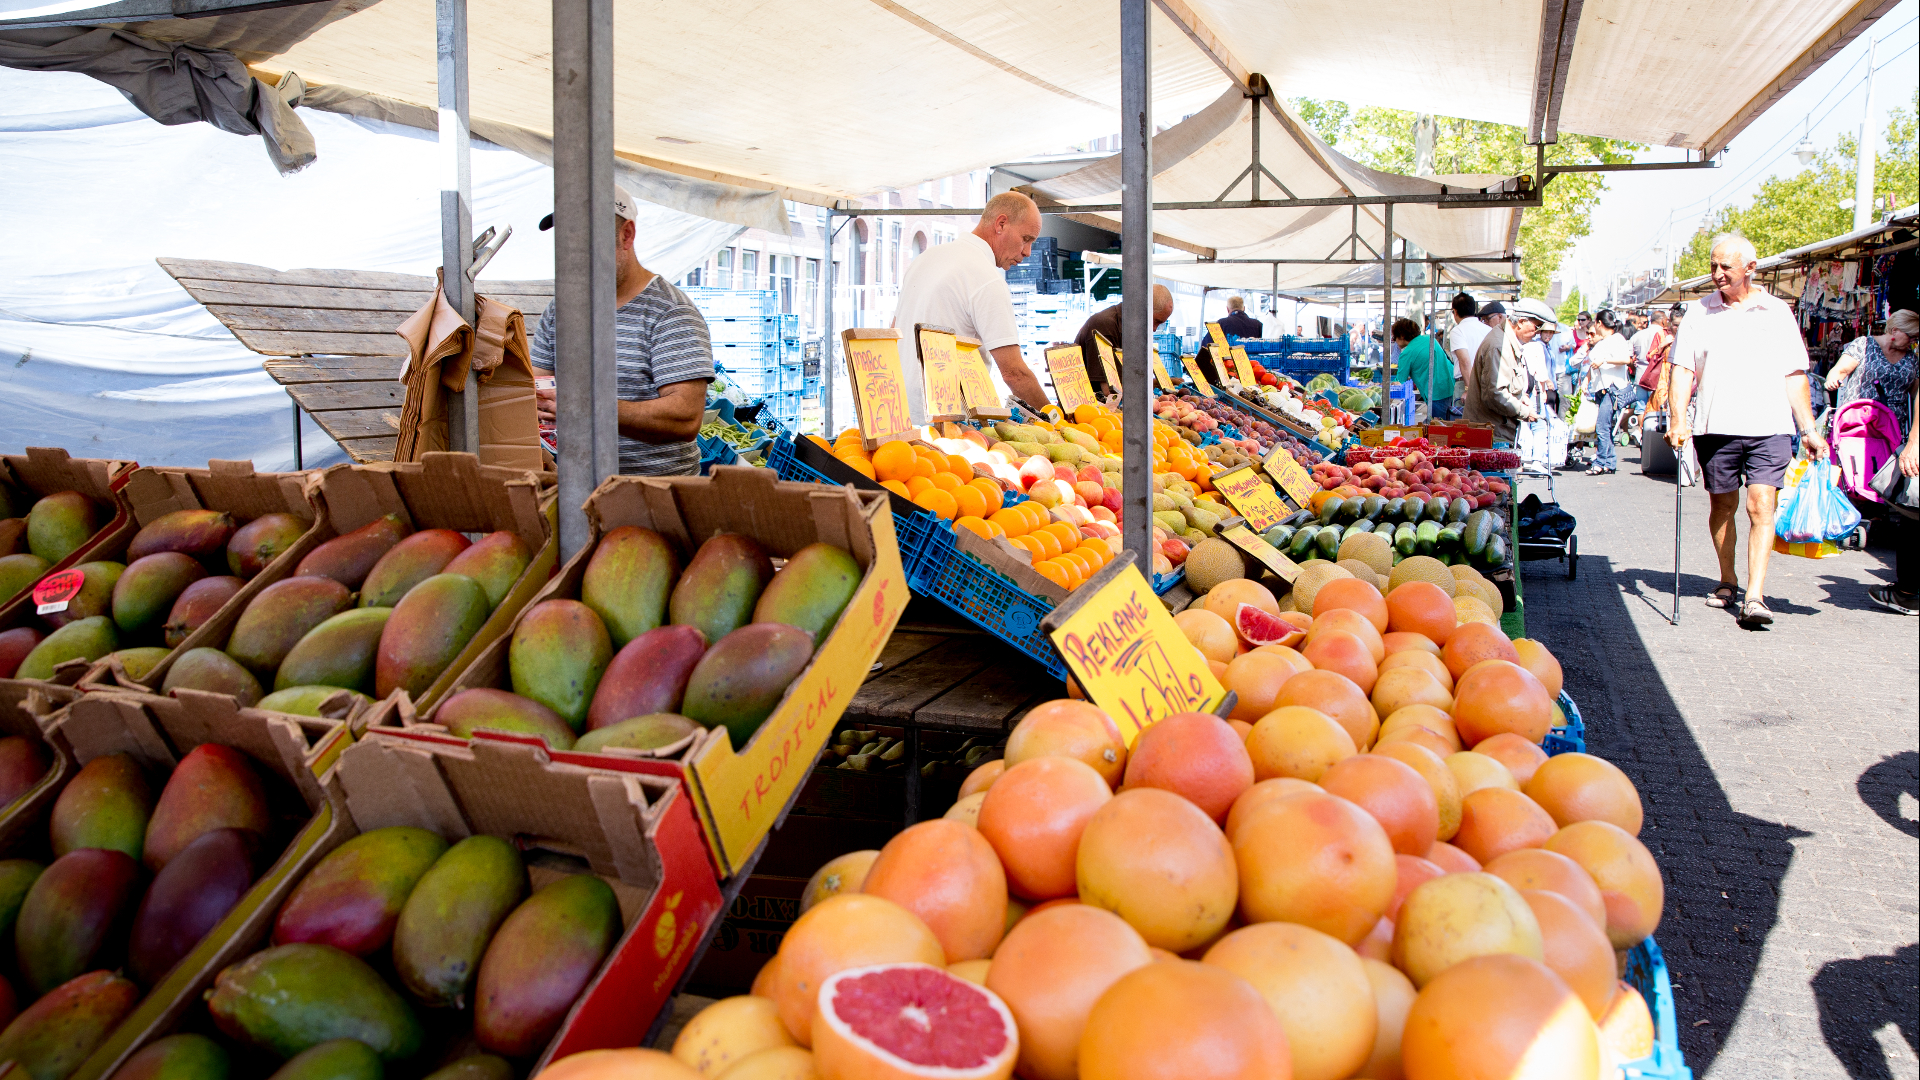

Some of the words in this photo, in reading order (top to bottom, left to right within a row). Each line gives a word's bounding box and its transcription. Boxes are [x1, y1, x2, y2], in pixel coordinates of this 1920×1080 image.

[853, 349, 887, 371] MAROC
[1063, 590, 1149, 679] REKLAME
[739, 676, 838, 821] TROPICAL
